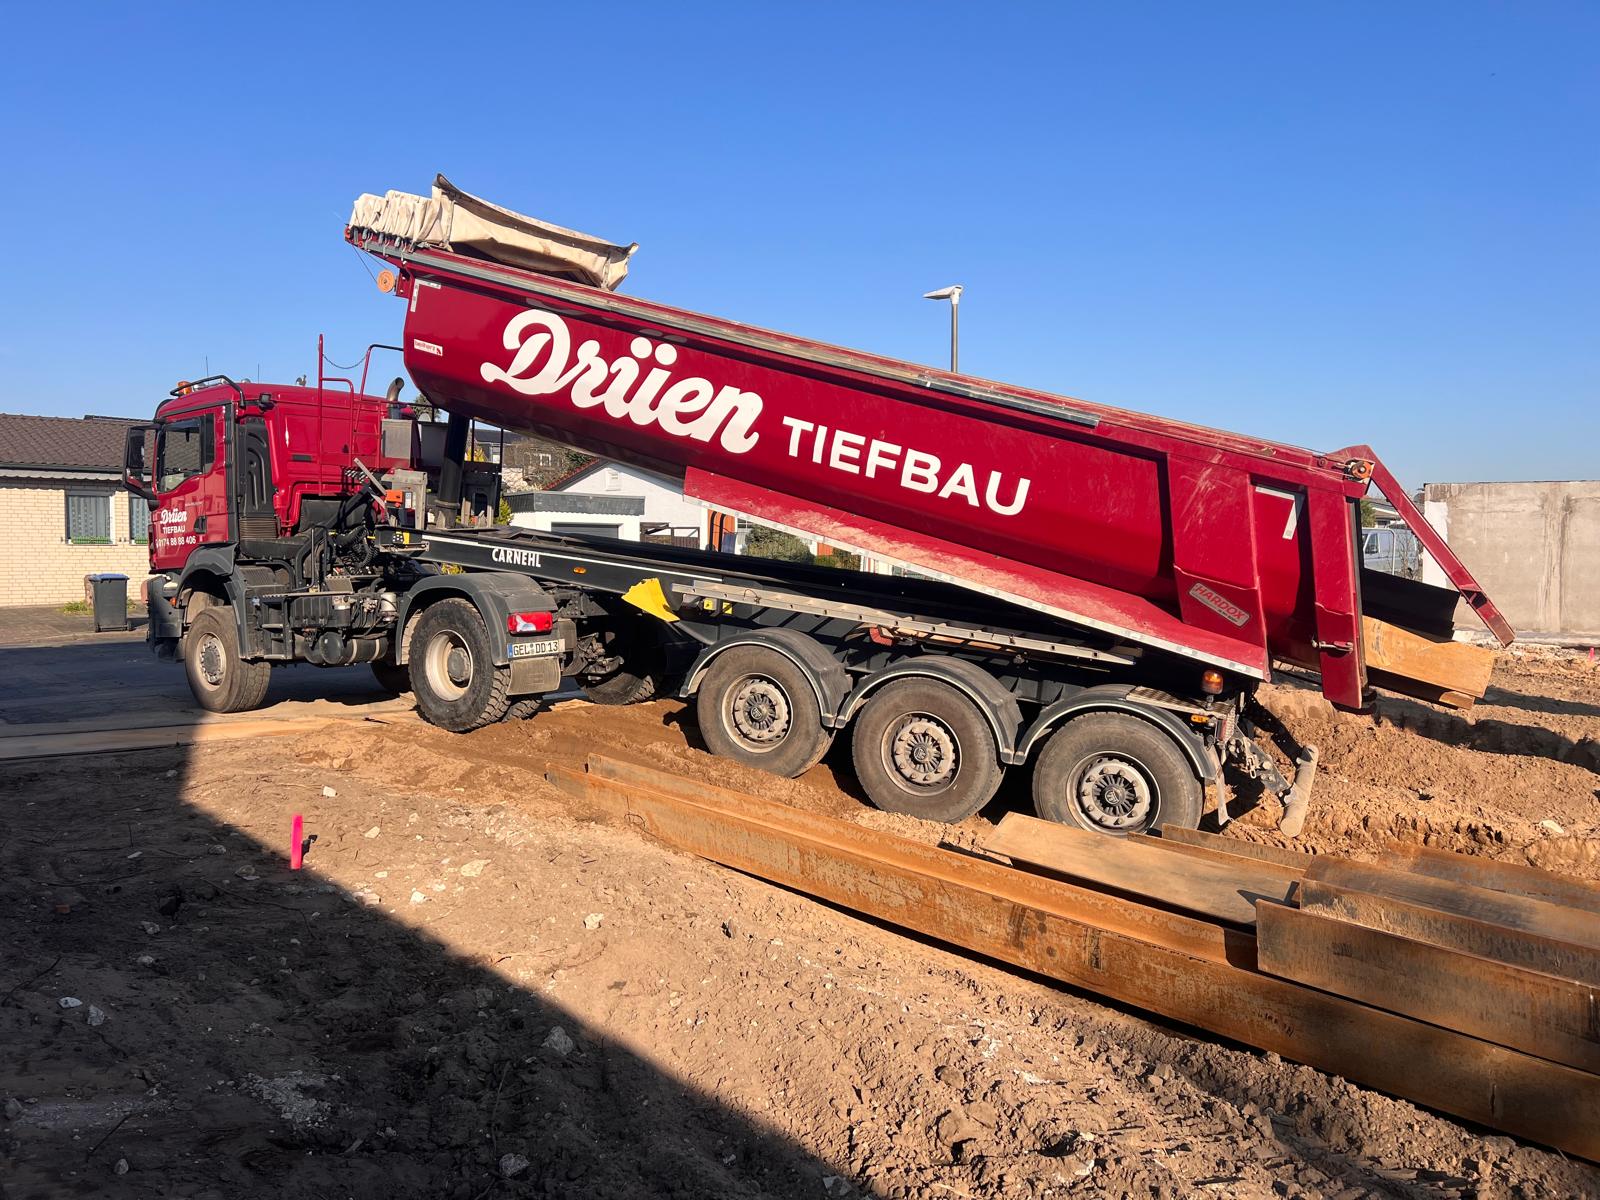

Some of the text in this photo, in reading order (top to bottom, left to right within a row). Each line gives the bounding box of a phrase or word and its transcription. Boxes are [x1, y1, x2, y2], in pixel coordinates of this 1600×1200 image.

[480, 309, 1031, 516] Drüen TIEFBAU
[160, 508, 187, 525] Drüen
[163, 525, 185, 535] TIEFBAU
[170, 537, 178, 546] 88
[178, 536, 185, 545] 88
[186, 536, 196, 545] 406
[492, 547, 541, 568] CARNEHL
[1196, 586, 1245, 619] HARDOX
[513, 641, 558, 656] GEL DD 13
